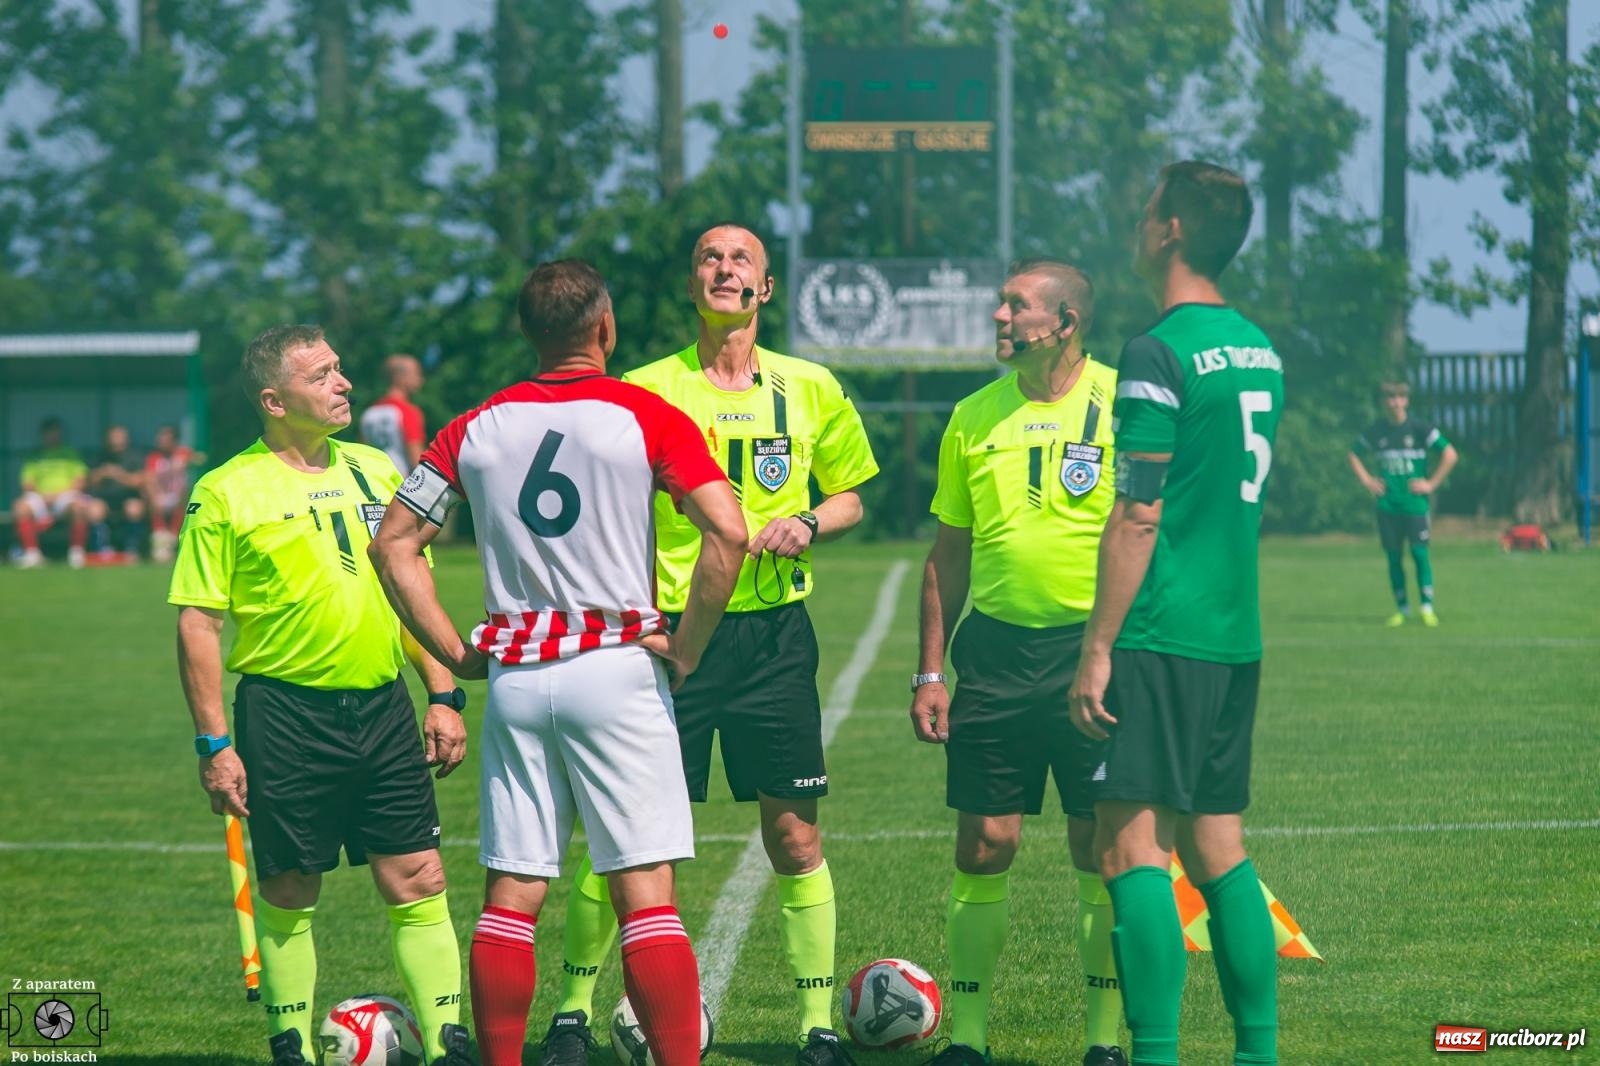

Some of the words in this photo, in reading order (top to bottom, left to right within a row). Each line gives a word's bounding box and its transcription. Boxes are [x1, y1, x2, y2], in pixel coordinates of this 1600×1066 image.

[716, 412, 755, 422] zina
[1239, 390, 1272, 503] 5
[518, 428, 581, 538] 6
[793, 775, 827, 788] zina
[563, 959, 598, 977] zina
[794, 976, 833, 989] zina
[951, 980, 979, 993] ina
[1086, 974, 1120, 990] zin
[264, 1001, 306, 1015] zina
